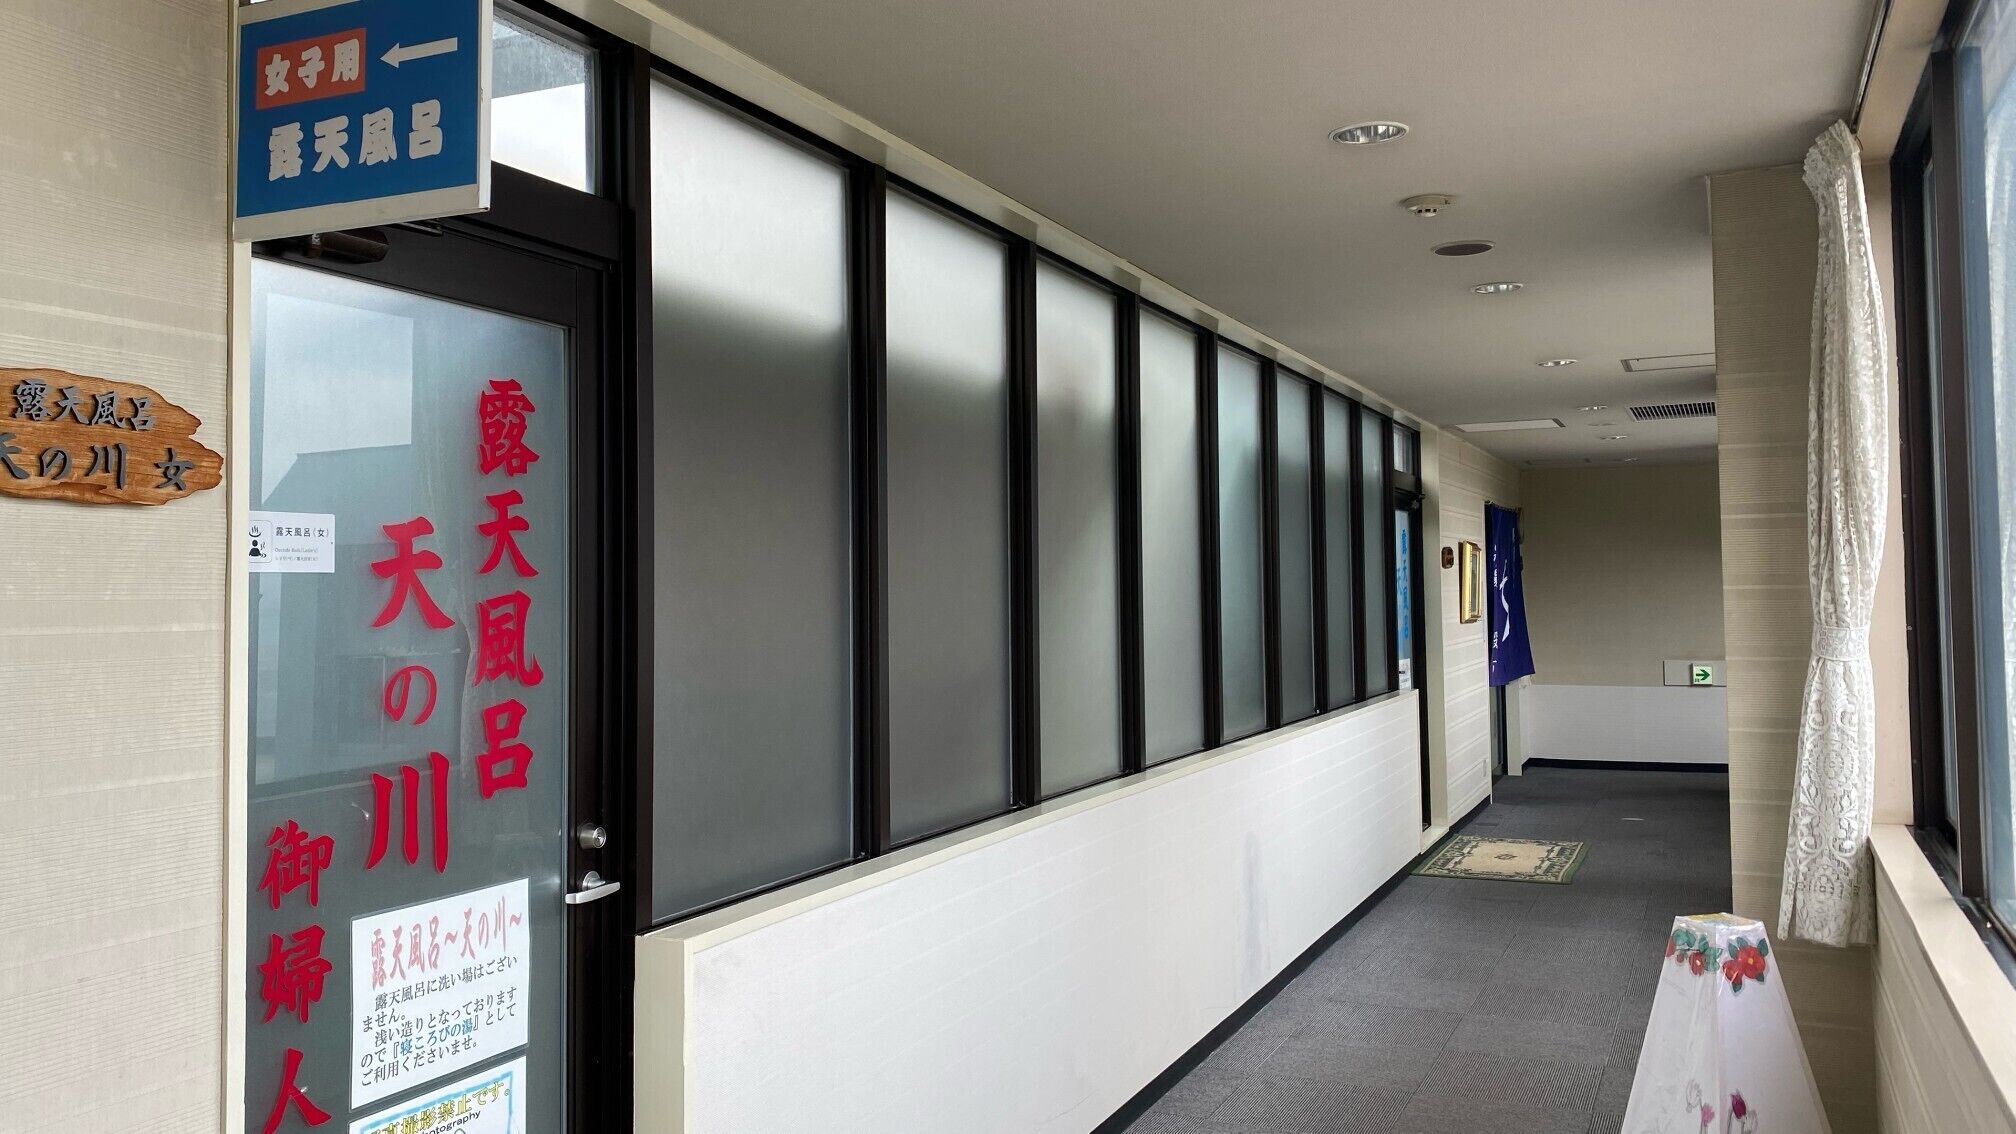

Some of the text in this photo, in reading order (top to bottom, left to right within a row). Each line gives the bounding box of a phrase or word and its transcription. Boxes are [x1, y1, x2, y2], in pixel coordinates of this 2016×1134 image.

[264, 38, 360, 97] 女子用
[268, 98, 443, 182] 露天風呂
[13, 378, 157, 432] 露天風呂
[154, 447, 195, 491] 女
[476, 379, 543, 801] 露天風呂
[366, 516, 455, 873] 天の川
[259, 818, 334, 1134] 御婦人
[374, 954, 518, 1012] 露天風呂に洗い場はござい
[360, 1003, 516, 1069] ので『寝ころびの湯』として
[362, 1007, 408, 1033] ません。
[374, 986, 518, 1047] 浅い造りとなっております
[361, 1035, 478, 1087] ご利用くださいませ。
